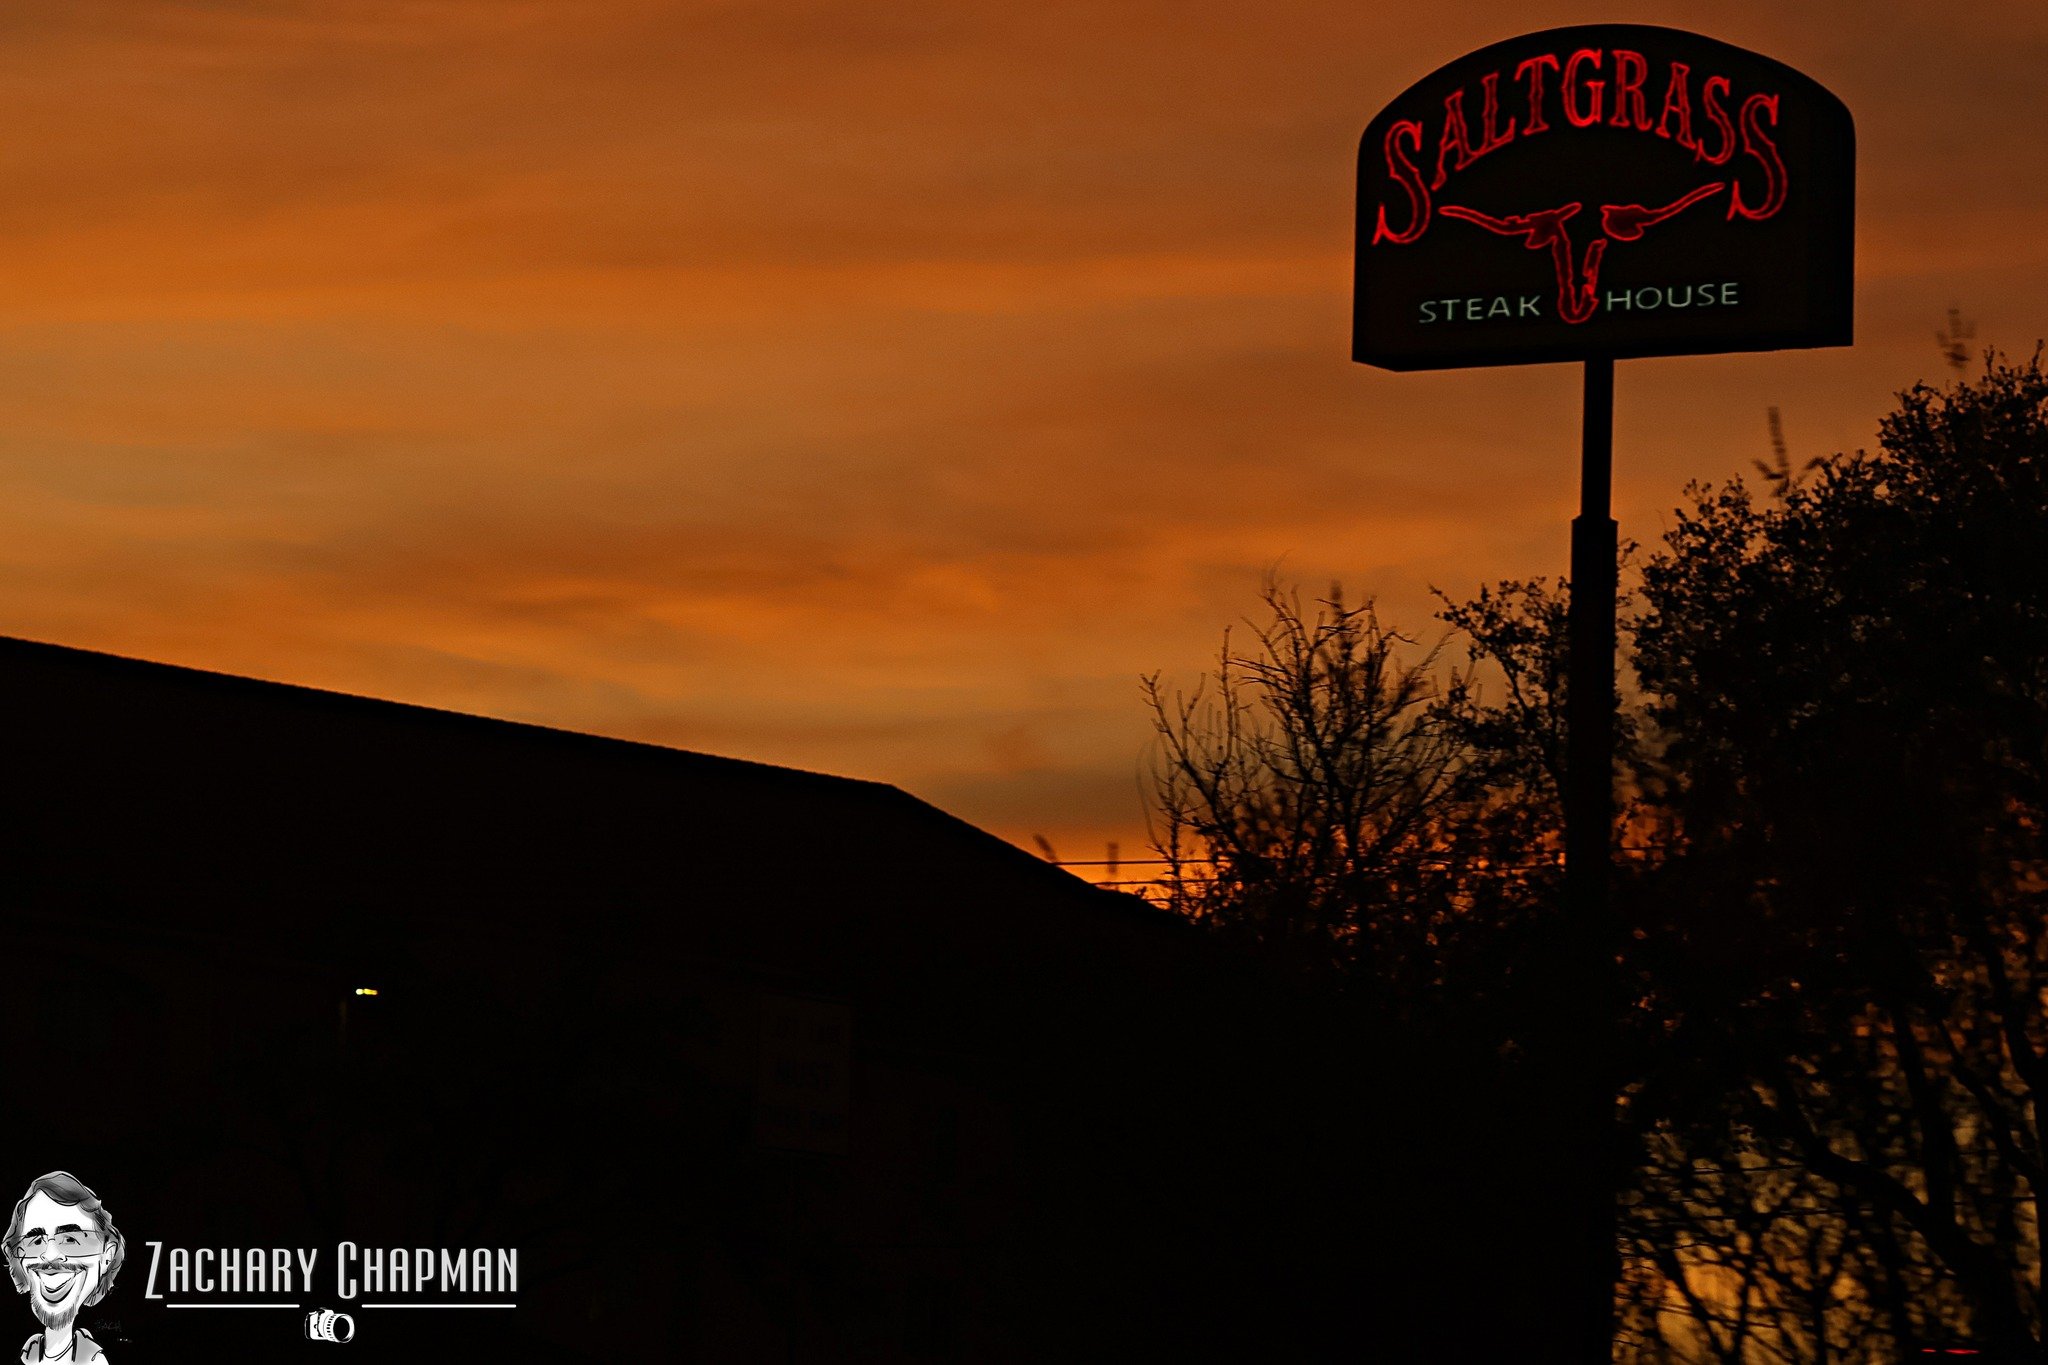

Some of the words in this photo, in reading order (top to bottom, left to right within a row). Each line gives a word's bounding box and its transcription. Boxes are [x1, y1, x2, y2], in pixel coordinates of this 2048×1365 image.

[1371, 48, 1789, 246] SALTGRASS
[1418, 295, 1542, 323] STEAK
[1605, 282, 1740, 312] HOUSE
